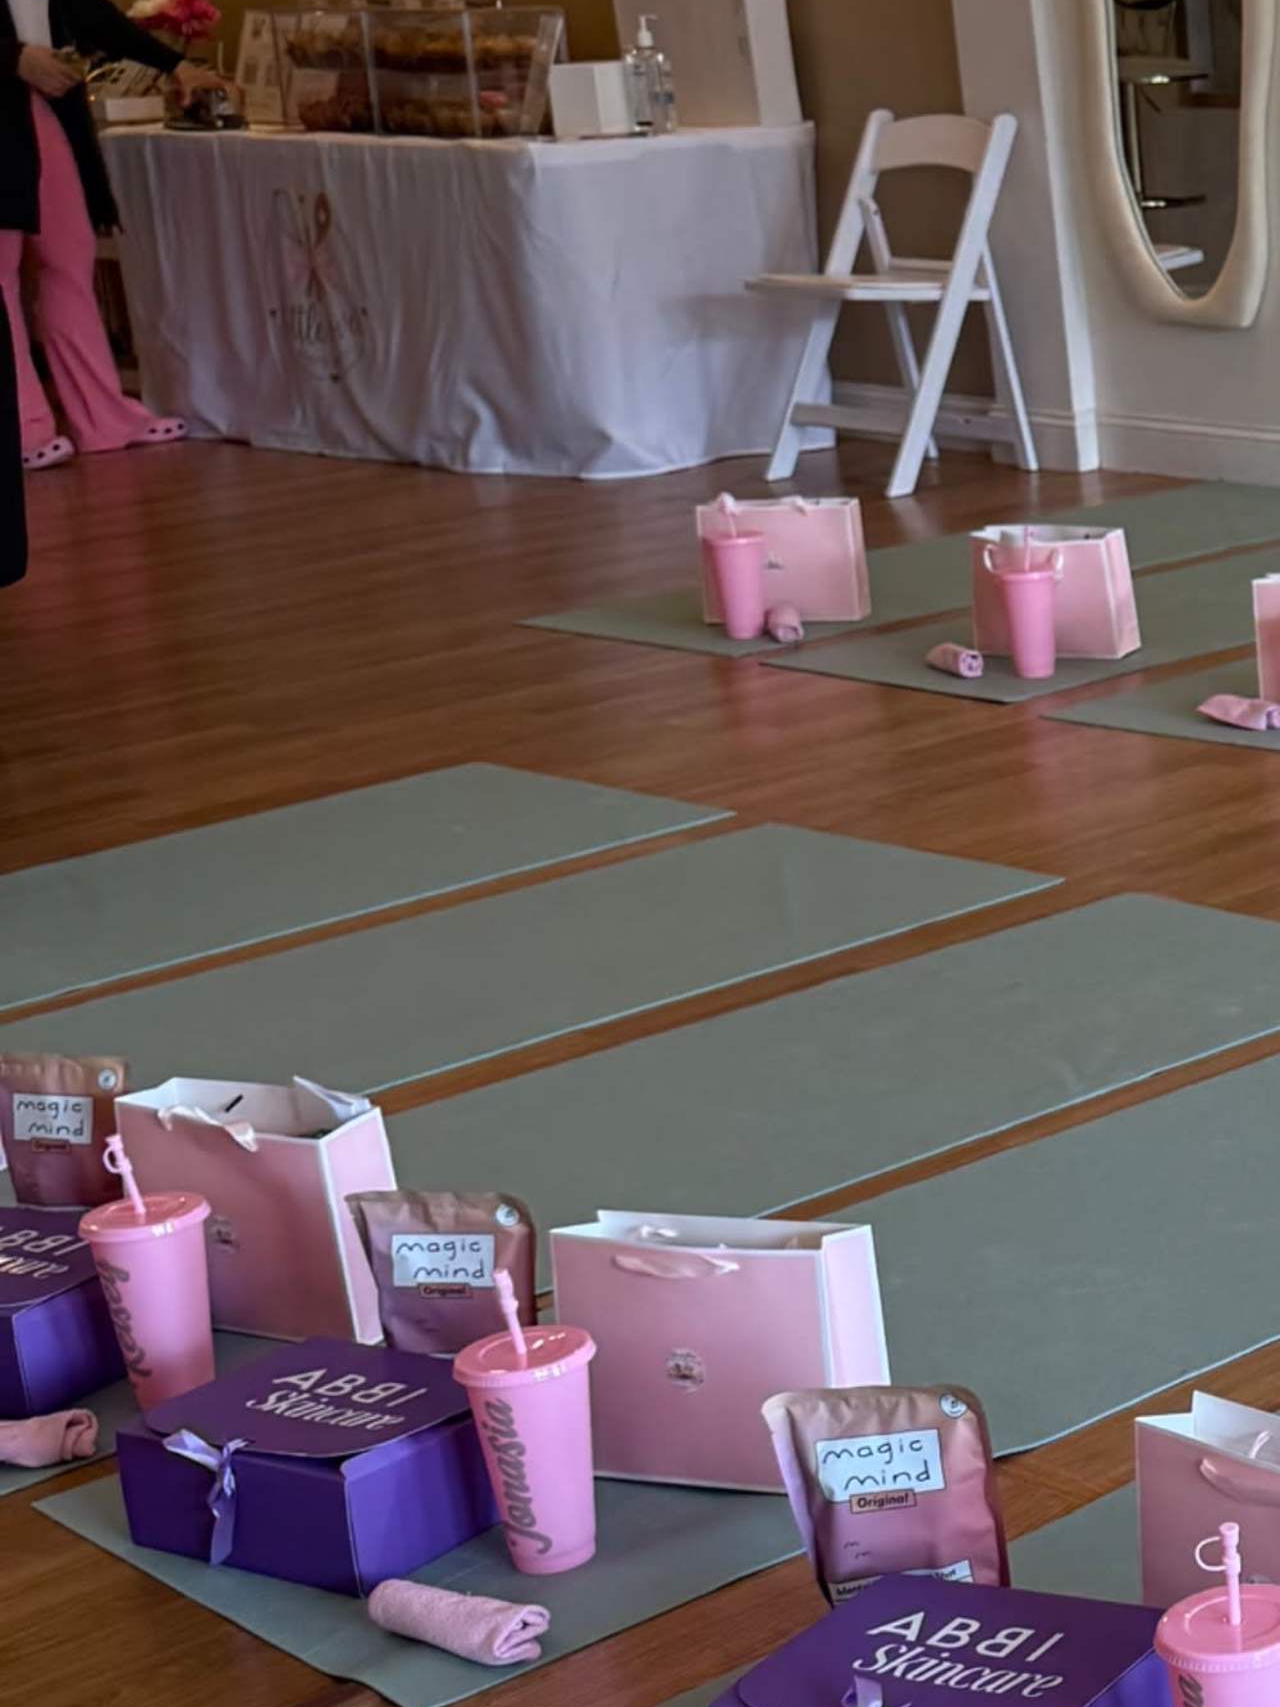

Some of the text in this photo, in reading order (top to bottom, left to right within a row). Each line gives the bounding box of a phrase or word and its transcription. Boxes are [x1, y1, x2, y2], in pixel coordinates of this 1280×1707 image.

[16, 1098, 83, 1118] magic
[28, 1120, 84, 1137] mind
[0, 1226, 90, 1256] BBI
[396, 1238, 482, 1261] magic
[413, 1260, 485, 1279] mind
[272, 1368, 429, 1408] ABBI
[245, 1389, 405, 1430] Skincare
[822, 1438, 923, 1465] magic
[844, 1459, 931, 1491] mind
[857, 1493, 909, 1509] Original
[865, 1611, 1064, 1662] ABBI
[852, 1643, 1063, 1698] Skincare
